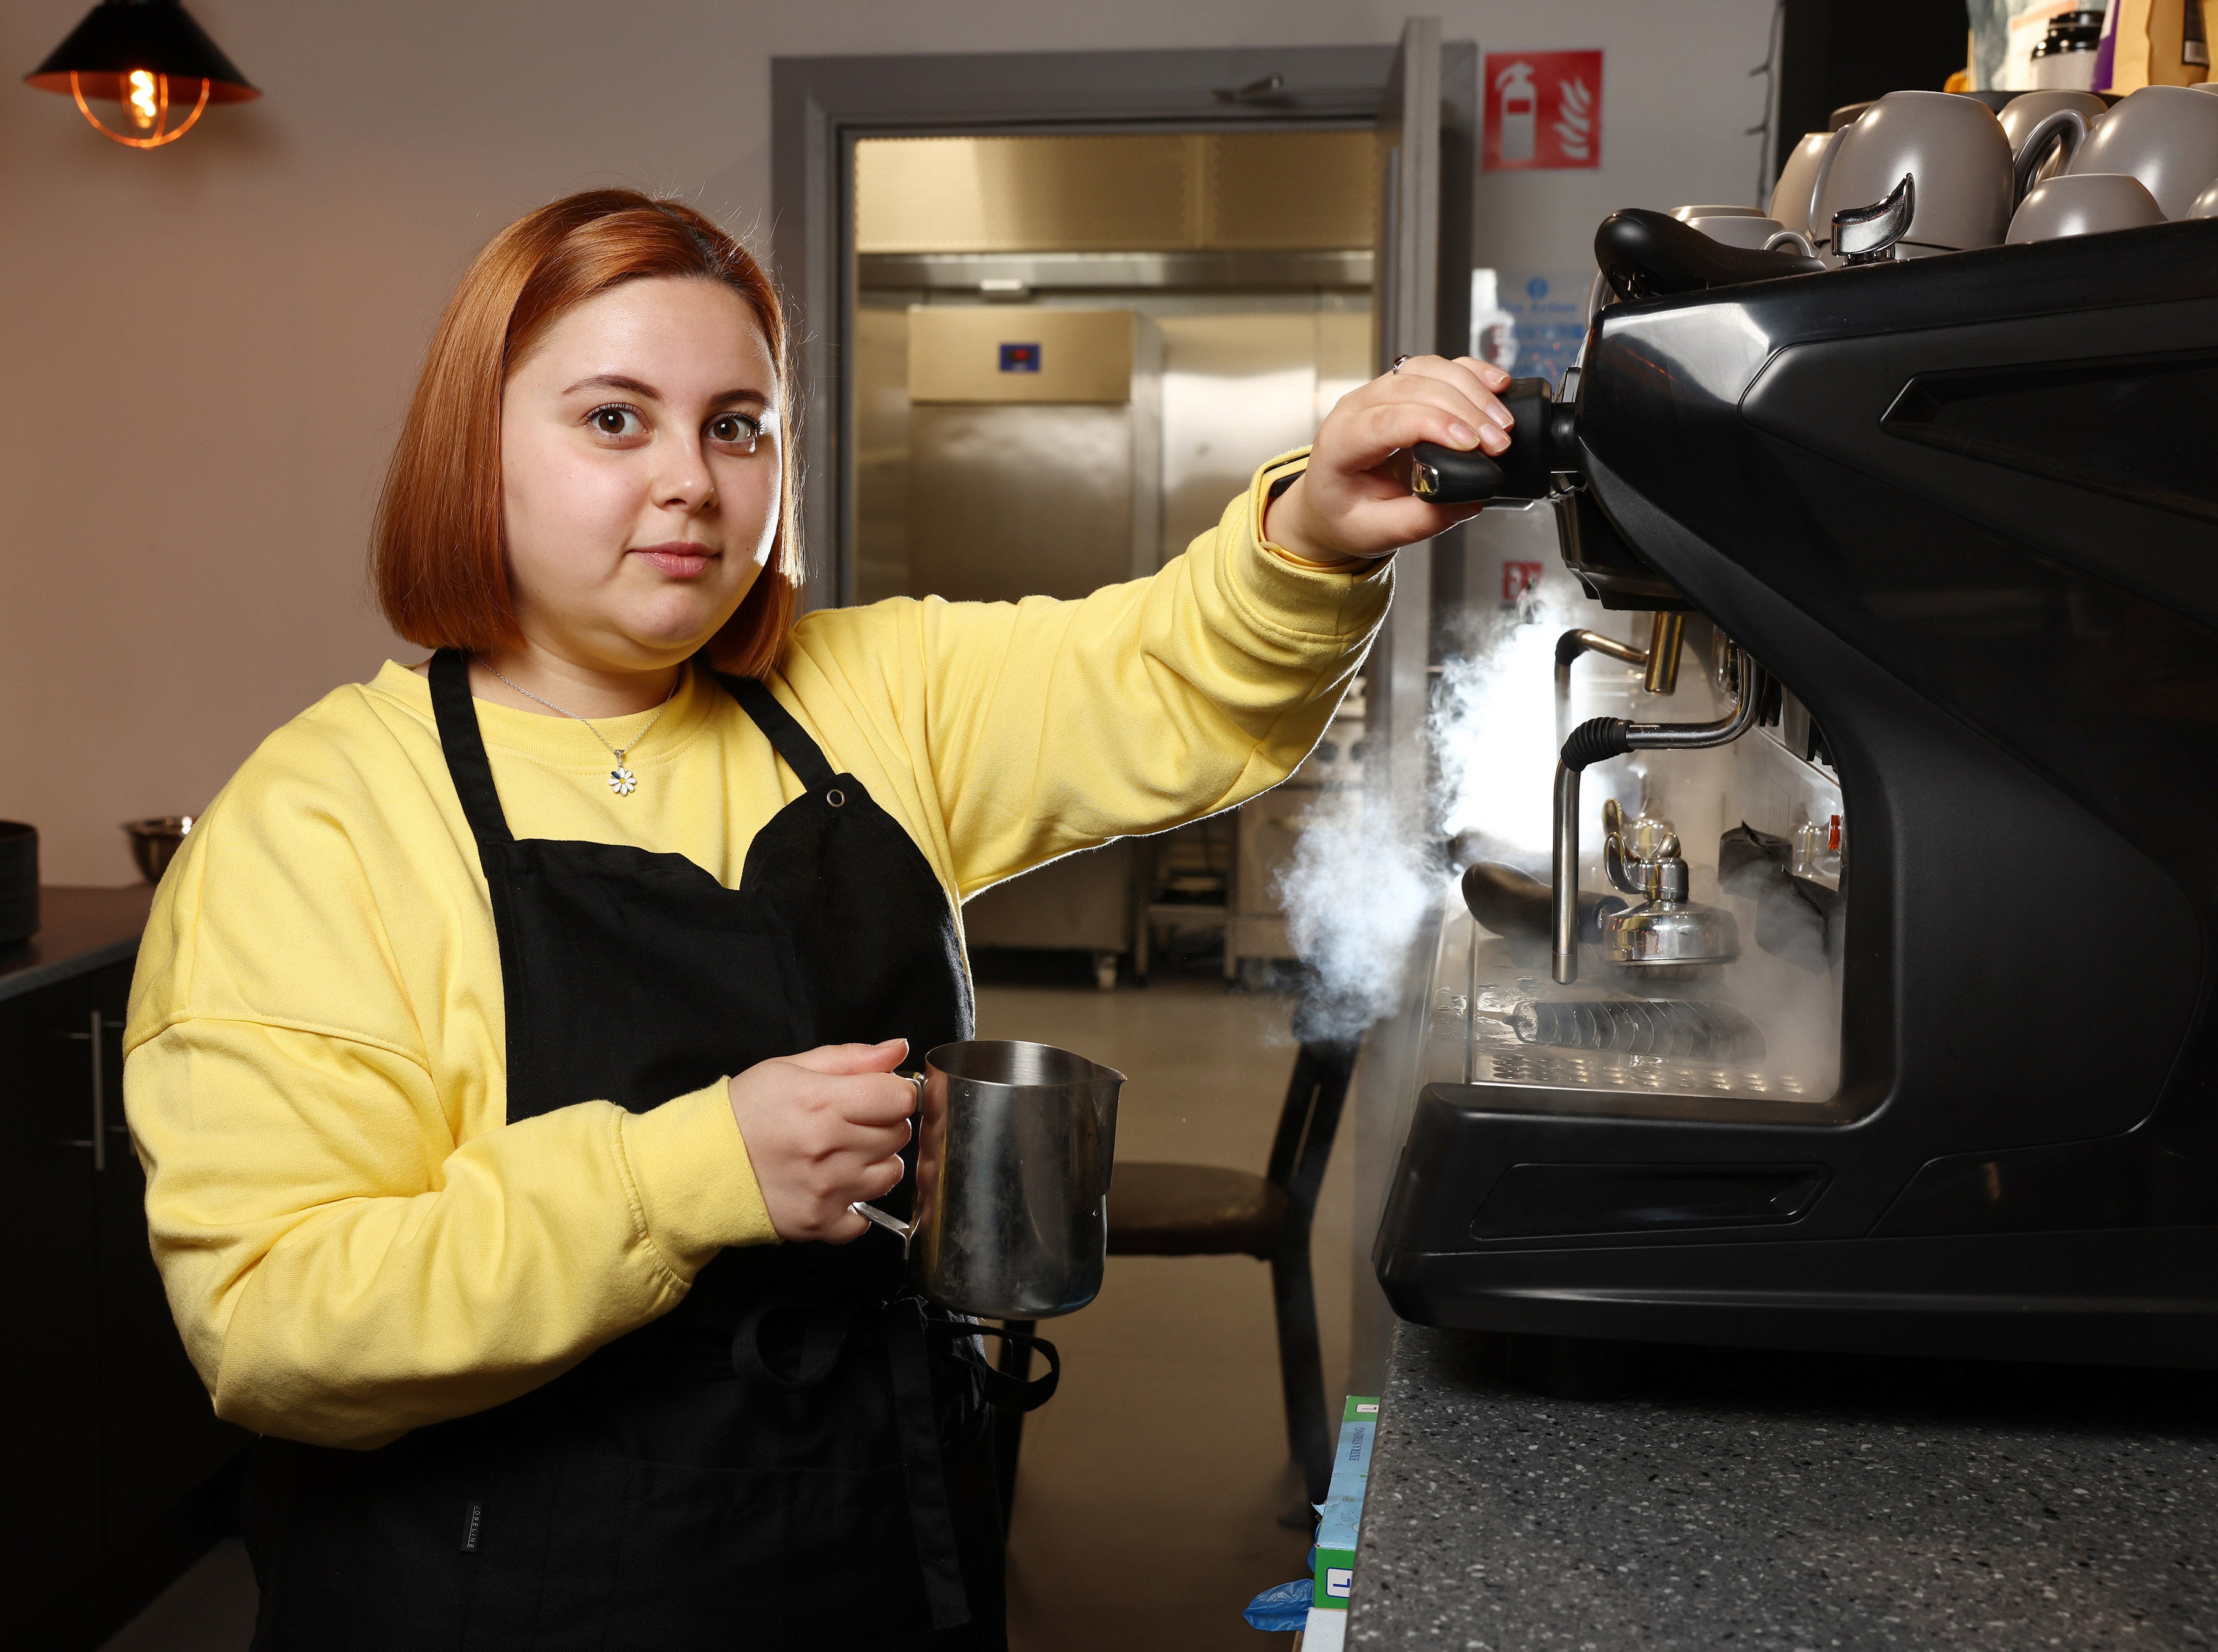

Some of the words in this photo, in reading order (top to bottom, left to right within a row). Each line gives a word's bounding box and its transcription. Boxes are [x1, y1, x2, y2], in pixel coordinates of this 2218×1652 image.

[1352, 1427, 1365, 1445] STRONG
[1349, 1446, 1362, 1461] EXTRA
[469, 1505, 481, 1548] JOSELINE
[1333, 1579, 1350, 1588] L
